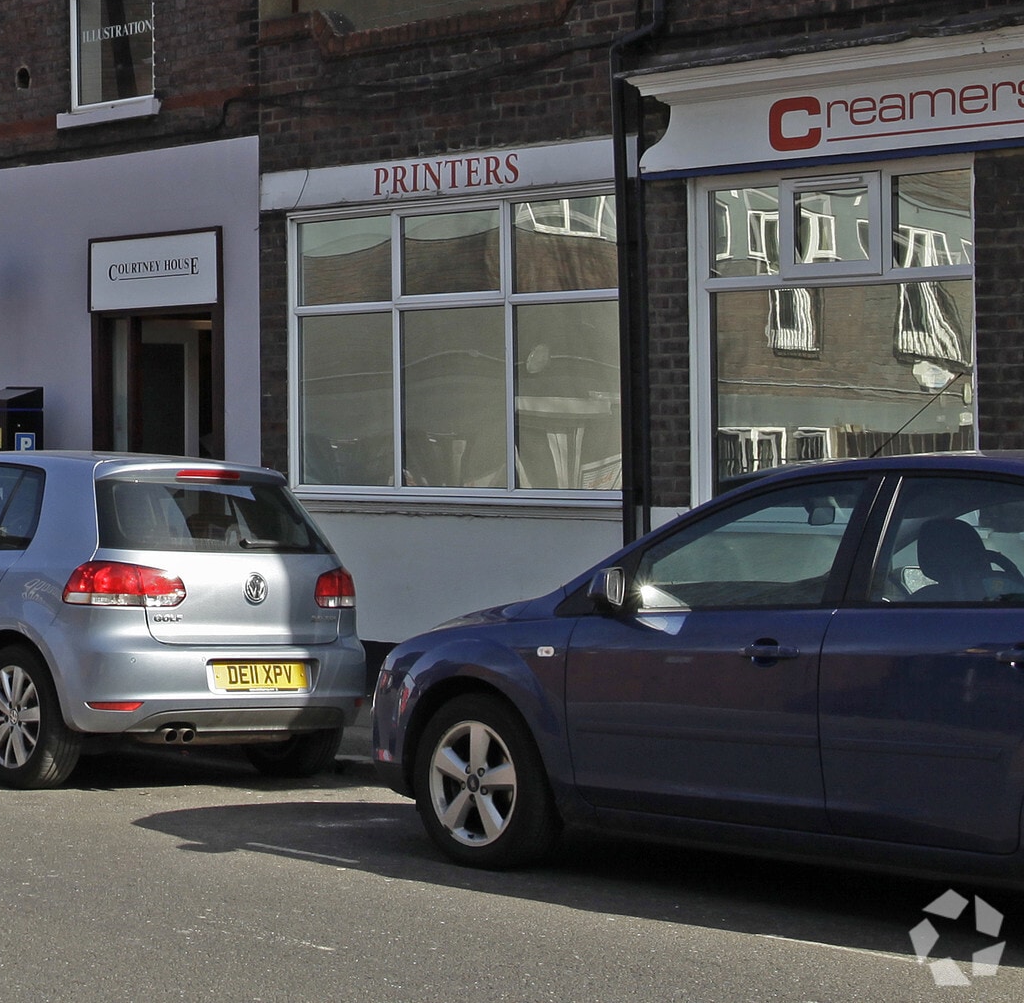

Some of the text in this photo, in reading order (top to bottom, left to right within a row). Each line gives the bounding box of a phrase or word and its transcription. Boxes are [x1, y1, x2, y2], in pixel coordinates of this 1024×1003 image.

[82, 19, 152, 43] ILLUSTRATION
[373, 154, 519, 196] PRINTERS
[108, 257, 200, 281] COURTNEY HOUSE
[20, 438, 32, 451] P
[154, 614, 183, 622] GOLF
[227, 665, 292, 684] DE11 XPV
